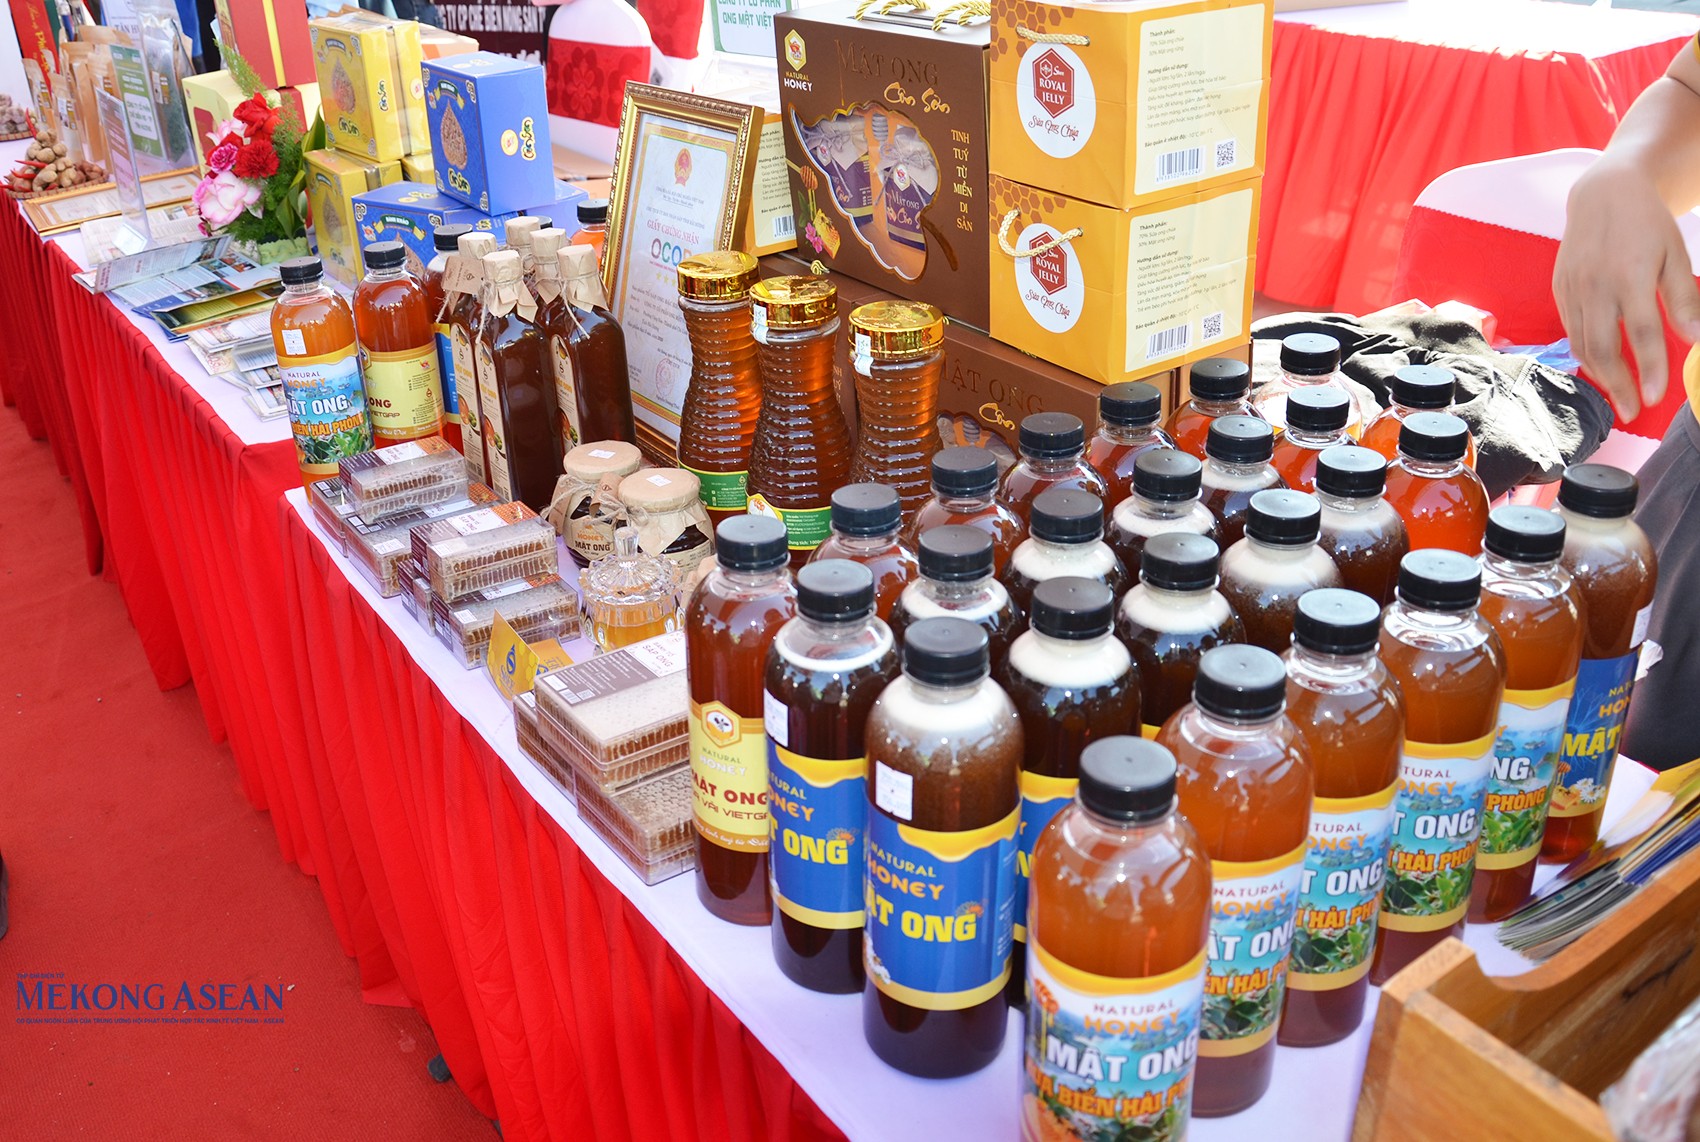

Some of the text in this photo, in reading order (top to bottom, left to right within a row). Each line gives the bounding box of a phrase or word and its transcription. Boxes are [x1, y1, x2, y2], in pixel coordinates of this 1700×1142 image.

[723, 10, 772, 30] ONG MẬT VIỆT
[785, 71, 809, 82] NATURAL
[891, 58, 939, 86] ONG
[784, 78, 813, 92] HONEY
[1039, 77, 1067, 93] ROYAL
[1042, 91, 1065, 105] JELLY
[951, 129, 970, 144] TINH
[956, 165, 968, 178] TỪ
[953, 181, 973, 198] MIỀN
[906, 200, 920, 210] ONG
[959, 201, 968, 214] DI
[647, 218, 700, 245] GIẤY CHỨNG NHẬN
[956, 215, 973, 232] SẢN
[1035, 257, 1061, 274] ROYAL
[1038, 269, 1060, 285] JELLY
[287, 370, 321, 379] NATURAL
[287, 378, 326, 389] HONEY
[943, 353, 1043, 416] ẬT ONG
[311, 394, 348, 416] ONG
[369, 396, 392, 409] ONG
[310, 420, 331, 437] HẢI
[332, 411, 364, 434] PHÒNG
[577, 532, 605, 541] HONEY
[592, 542, 611, 552] ONG
[1560, 723, 1622, 760] MẬT
[701, 747, 742, 764] NATURAL
[699, 754, 747, 777] HONEY
[1403, 766, 1452, 779] TURAL
[1489, 756, 1531, 782] NG
[1399, 779, 1457, 797] ONEY
[702, 797, 719, 813] VẢI
[723, 789, 768, 806] ONG
[768, 784, 815, 822] ONEY
[1486, 785, 1547, 812] PHÒNG
[1315, 822, 1363, 834] TURAL
[1414, 808, 1476, 840] ONG
[783, 828, 849, 865] ONG
[1306, 832, 1369, 852] ONEY
[870, 841, 937, 878] NATURAL
[1396, 849, 1436, 873] HẢI
[868, 855, 945, 901] HONEY
[1326, 857, 1383, 897] ONG
[1213, 880, 1284, 897] NATURAL
[901, 910, 977, 943] ONG
[1308, 906, 1347, 929] HẢI
[1232, 967, 1269, 995] HẢI
[1093, 999, 1175, 1017] NATURAL
[1083, 1009, 1181, 1036] HONEY
[1047, 1034, 1128, 1085] MẬT
[1138, 1028, 1199, 1081] ONG
[1056, 1083, 1117, 1118] BIỂN
[1121, 1090, 1163, 1119] HẢI
